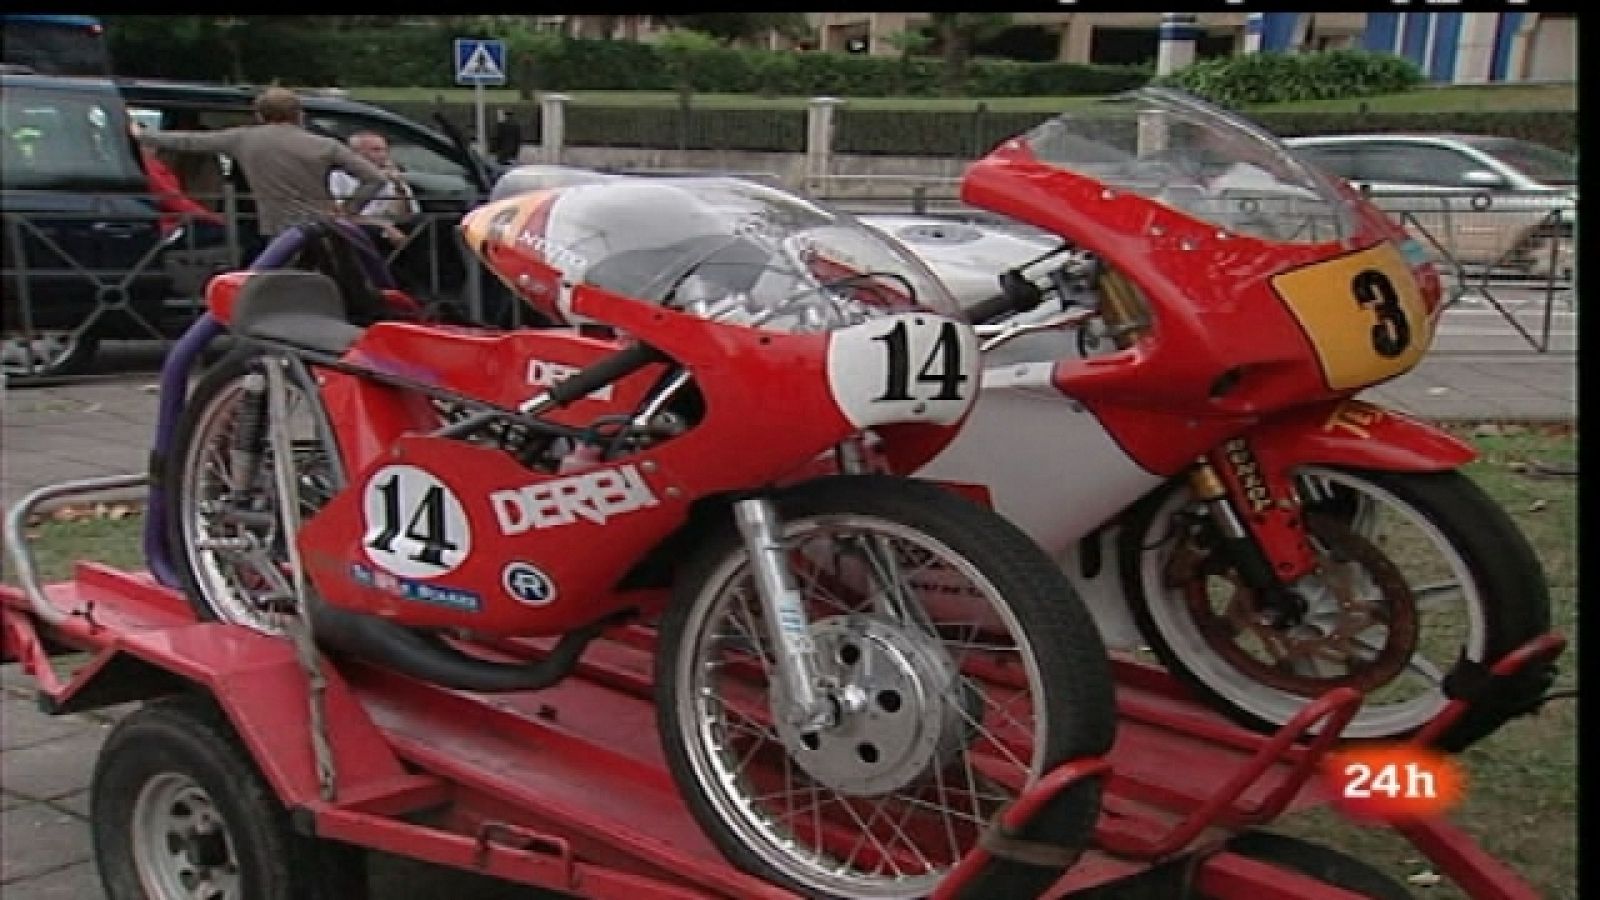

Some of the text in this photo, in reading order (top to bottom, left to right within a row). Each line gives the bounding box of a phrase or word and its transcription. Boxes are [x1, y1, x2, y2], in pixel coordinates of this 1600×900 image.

[1352, 269, 1411, 358] 3
[870, 319, 967, 402] 14
[369, 474, 458, 568] 14
[490, 464, 660, 535] DERBI
